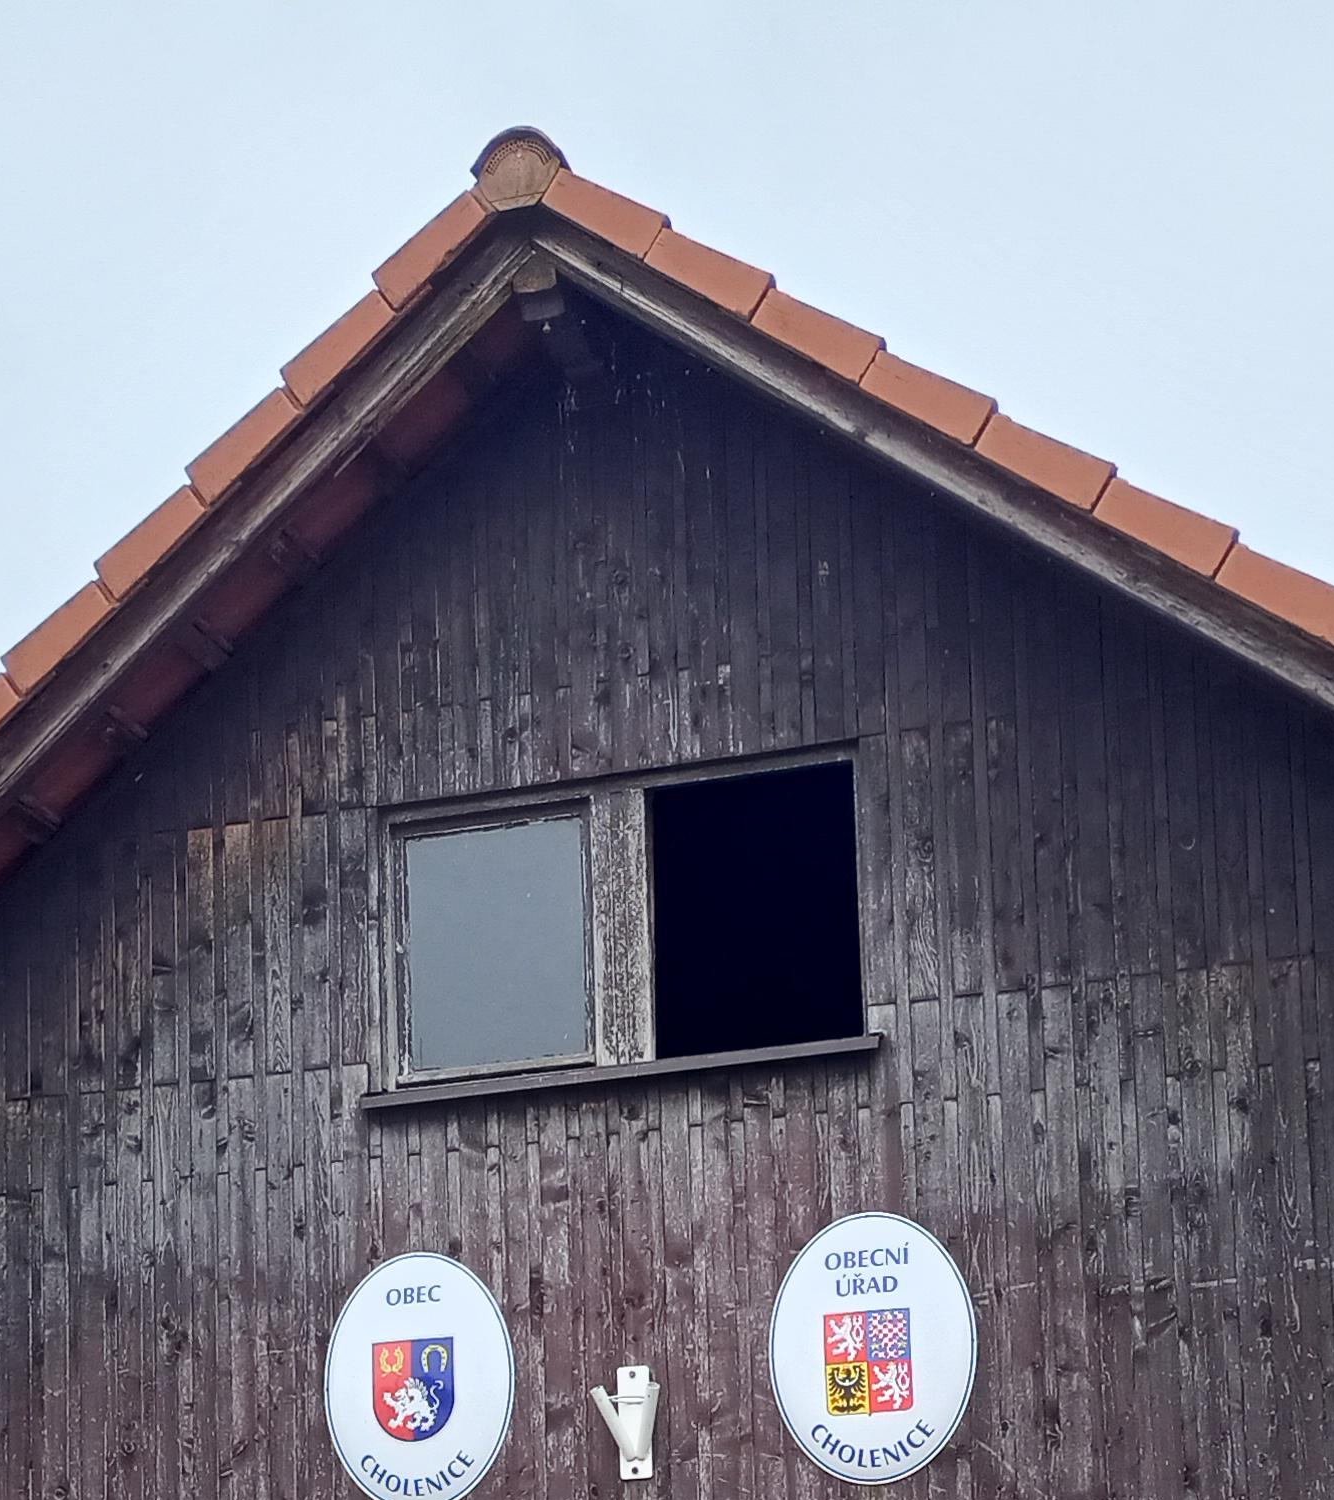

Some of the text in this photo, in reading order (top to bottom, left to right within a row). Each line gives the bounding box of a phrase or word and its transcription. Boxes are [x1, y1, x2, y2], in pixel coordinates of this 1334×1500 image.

[824, 1241, 910, 1270] OBECNÍ
[385, 1284, 442, 1306] OBEC
[835, 1273, 898, 1297] ÚŘAD
[810, 1418, 935, 1468] CHOLENICE
[359, 1449, 475, 1497] CHOLENICE
